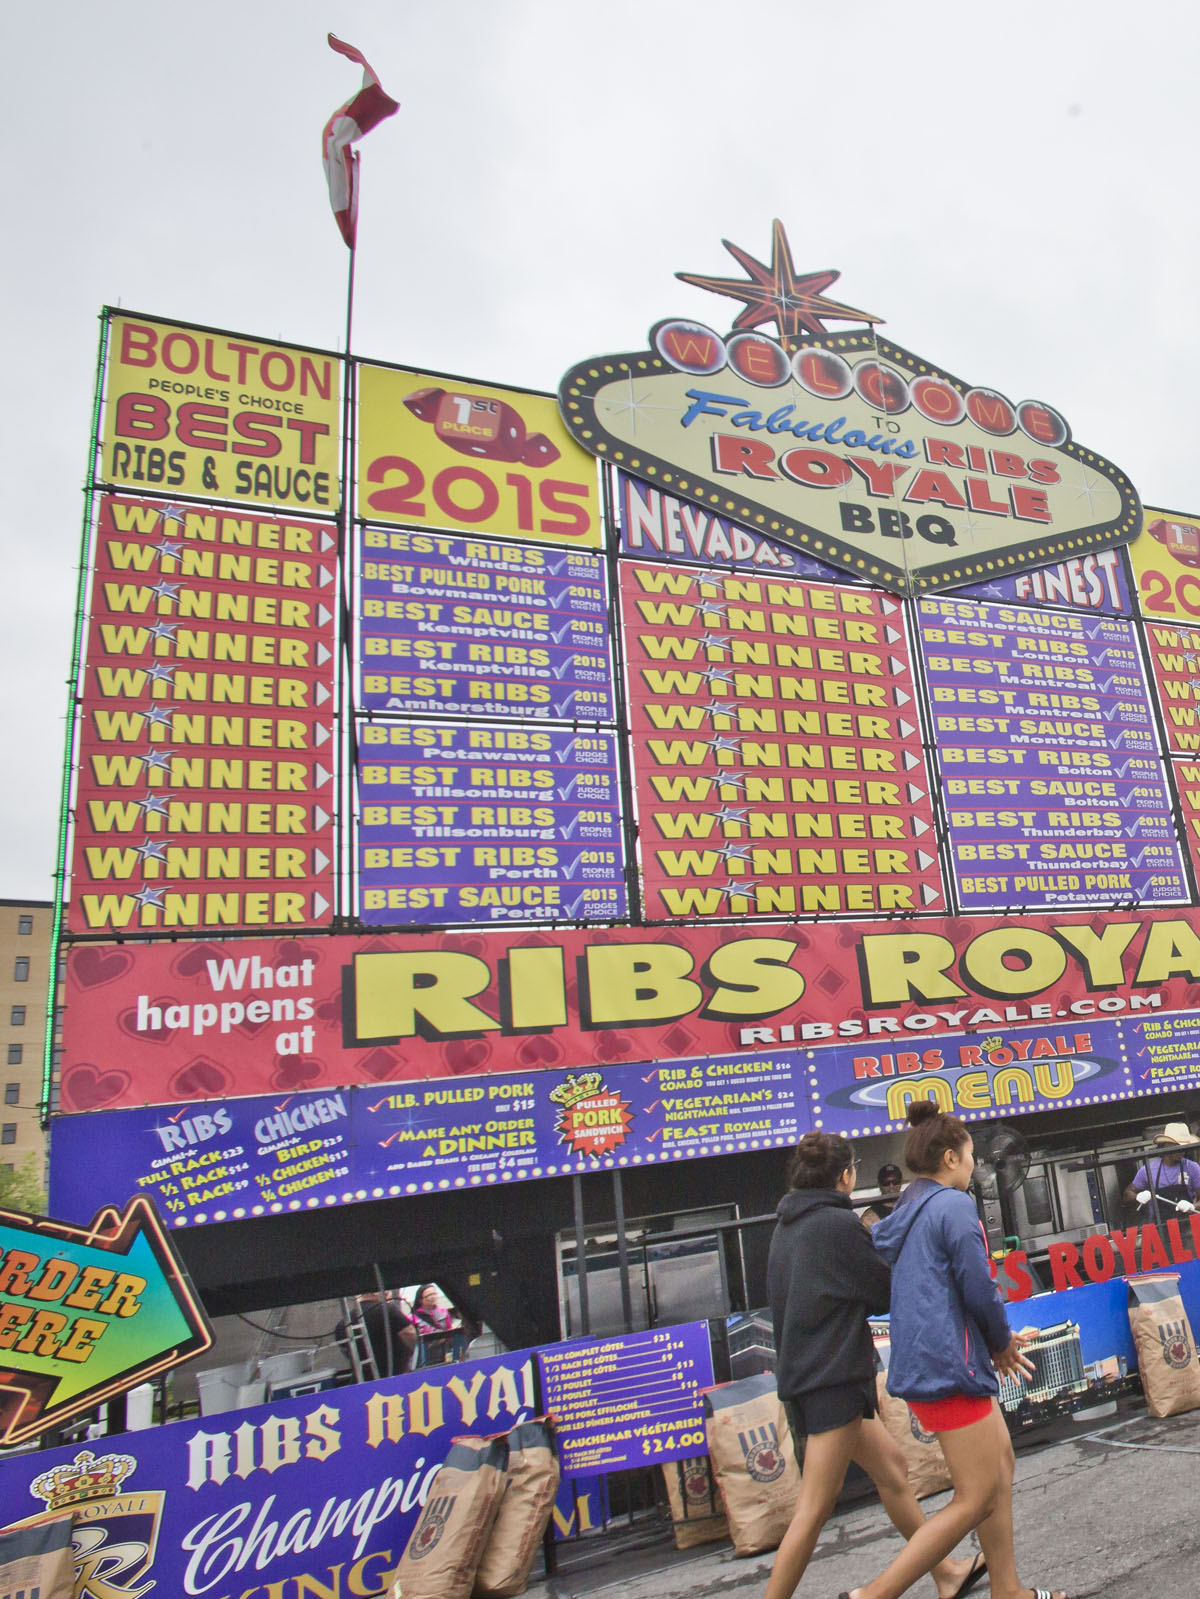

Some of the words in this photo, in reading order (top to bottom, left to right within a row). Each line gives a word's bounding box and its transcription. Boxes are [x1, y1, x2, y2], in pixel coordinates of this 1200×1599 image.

[119, 322, 332, 400] BOLTON
[149, 378, 230, 402] PEOPLE'S
[239, 394, 304, 415] CHOICE
[668, 333, 1055, 437] WELCOME
[115, 392, 330, 465] BEST
[442, 421, 493, 438] PLACE
[682, 388, 921, 459] Fabulous
[872, 416, 901, 434] TO
[112, 442, 187, 486] RIBS
[201, 455, 220, 490] &
[235, 461, 330, 506] SAUCE
[923, 436, 1062, 486] RIBS
[711, 432, 1055, 523] ROYALE
[366, 456, 592, 537] 2015
[838, 501, 960, 548] BBQ
[364, 531, 454, 555] BEST
[466, 543, 545, 566] RIBS
[448, 555, 546, 575] Windsor
[567, 555, 600, 568] 2015
[568, 566, 599, 575] JUDGES
[568, 572, 600, 580] CHOICE
[364, 563, 414, 582] BEST
[420, 568, 490, 590] PULLED
[496, 574, 546, 596] PORK
[1015, 551, 1123, 611] FINEST
[392, 584, 547, 607] Bowmanville
[569, 586, 601, 599] 2015
[363, 600, 443, 621] BEST
[453, 606, 550, 630] SAUCE
[920, 600, 989, 620] BEST
[999, 610, 1083, 631] SAUCE
[418, 622, 548, 642] Kemptville
[943, 617, 1086, 640] Amherstburg
[1100, 622, 1130, 633] 2015
[362, 766, 458, 785] BEST
[470, 768, 555, 787] RIBS
[411, 786, 554, 801] Tillsonburg
[951, 812, 1036, 827] BEST
[1048, 812, 1122, 827] RIBS
[1021, 827, 1122, 838] Thunderbay
[961, 876, 1008, 894] BEST
[1015, 875, 1079, 892] PULLED
[1085, 873, 1132, 890] PORK
[1045, 891, 1133, 902] Petawawa
[205, 955, 315, 992] What
[350, 938, 807, 1042] RIBS
[137, 995, 315, 1036] happens
[738, 993, 1162, 1046] RIBSROYALE.COM
[275, 1025, 314, 1057] at
[853, 1049, 945, 1080] RIBS
[959, 1033, 1094, 1067] ROYALE
[1150, 1051, 1192, 1064] NIGHTMARE
[659, 1069, 687, 1081] RIB
[691, 1066, 703, 1078] &
[706, 1061, 772, 1077] CHICKEN
[387, 1094, 420, 1109] 1LB.
[424, 1088, 485, 1106] PULLED
[489, 1083, 534, 1099] PORK
[660, 1079, 703, 1091] COMBO
[885, 1061, 1076, 1121] MENU
[513, 1099, 535, 1112] $15
[576, 1099, 618, 1110] PULLED
[661, 1089, 772, 1111] VEGETARIAN'S
[158, 1107, 233, 1152] RIBS
[254, 1094, 347, 1144] CHICKEN
[571, 1108, 624, 1128] PORK
[665, 1106, 728, 1122] NIGHTMARE
[399, 1128, 446, 1142] MAKE
[449, 1124, 482, 1137] ANY
[485, 1118, 534, 1132] ORDER
[574, 1125, 624, 1138] SANDWICH
[663, 1124, 720, 1141] FEAST
[724, 1119, 772, 1133] ROYALE
[276, 1139, 323, 1164] BIRD
[422, 1145, 436, 1157] A
[439, 1131, 536, 1156] DINNER
[138, 1170, 170, 1187] FULL
[170, 1150, 222, 1176] RACK
[180, 1166, 228, 1191] RACK
[272, 1153, 329, 1181] CHICKEN
[0, 1246, 147, 1319] RDER
[0, 1302, 110, 1364] ERE
[562, 1430, 632, 1450] CAUCHEMAR
[633, 1416, 703, 1437] VÉGÉTARIEN
[642, 1431, 705, 1456] $24.00
[184, 1404, 342, 1491] RIBS
[73, 1499, 145, 1521] ROYALE
